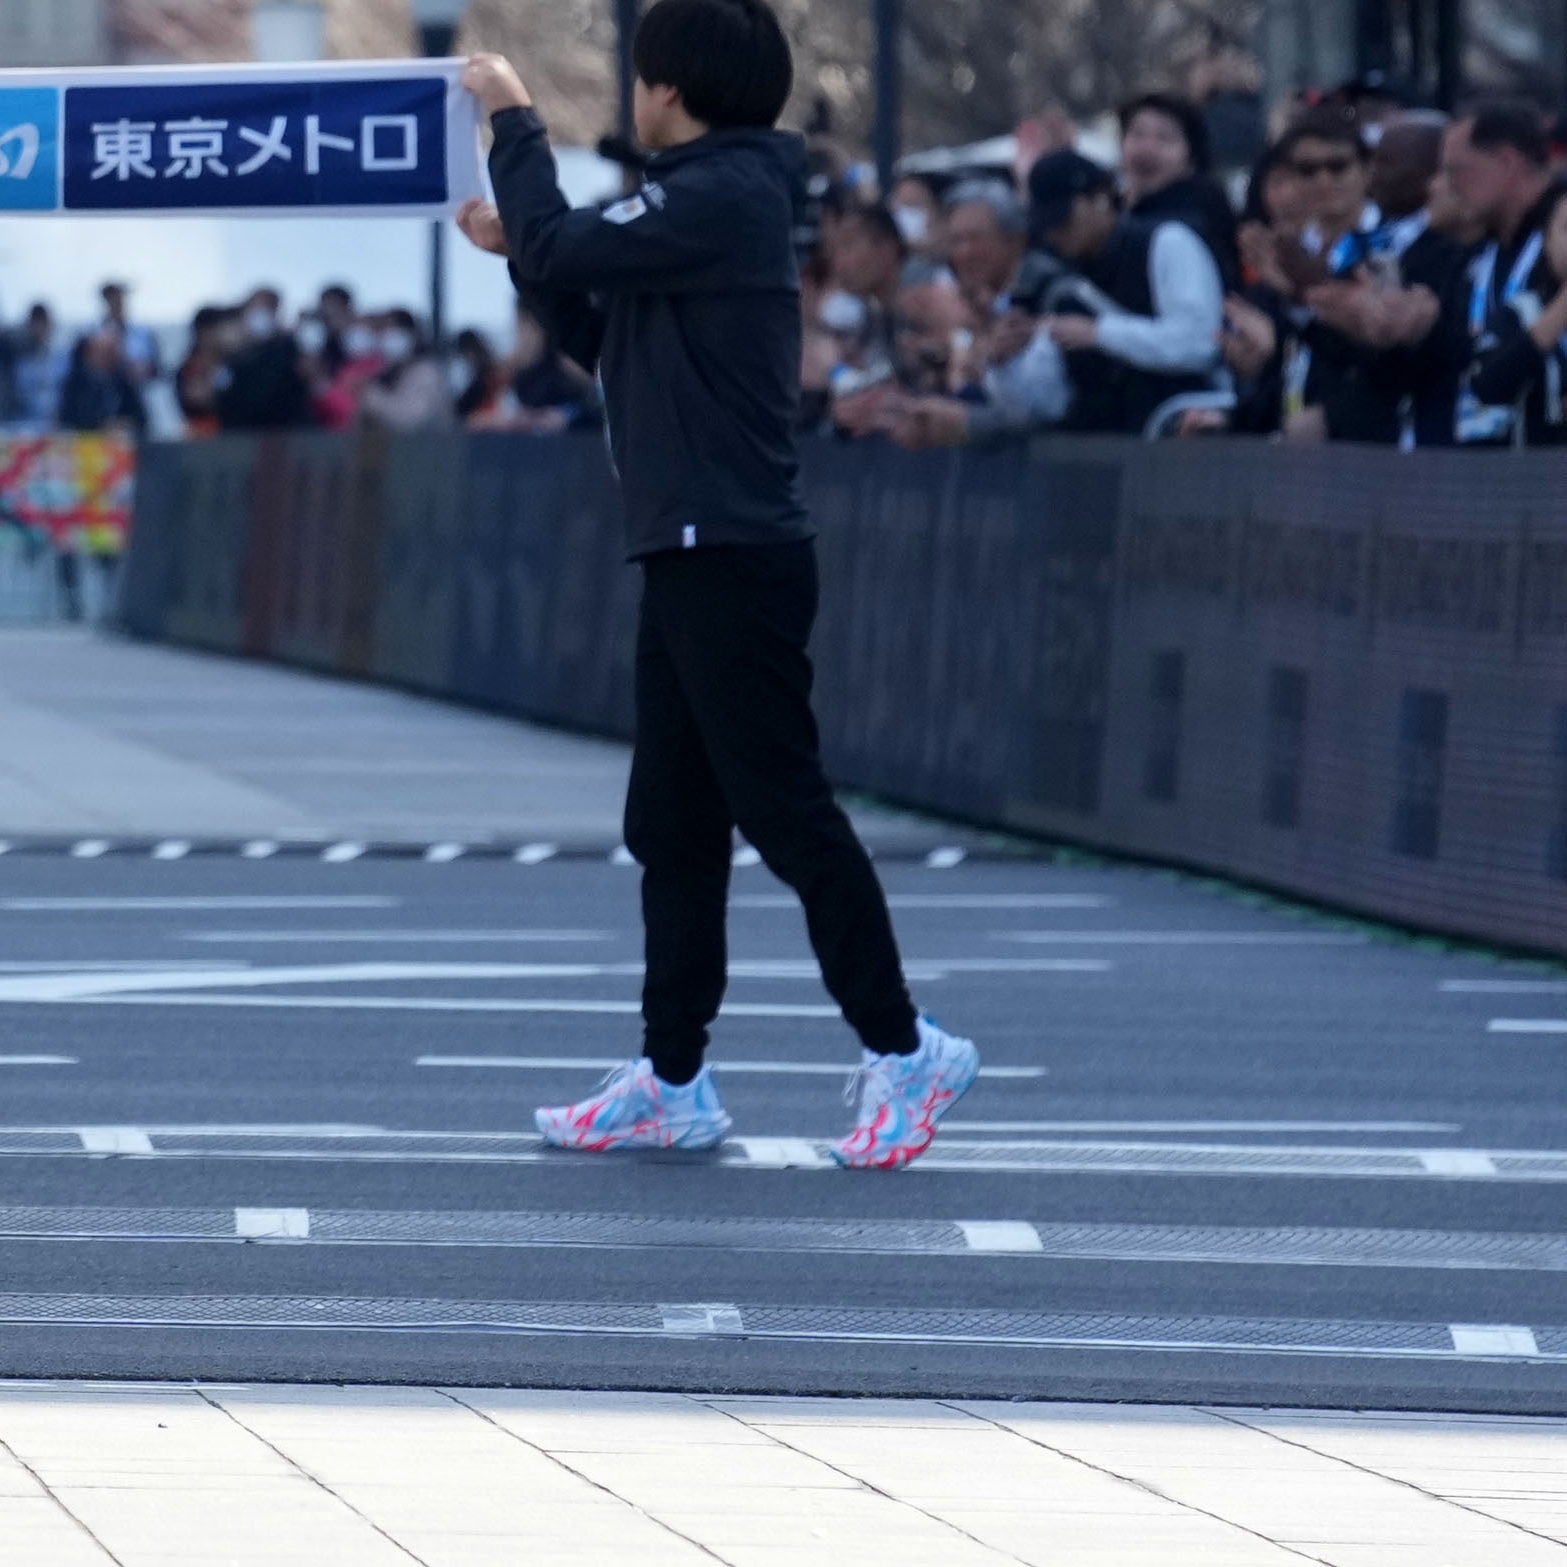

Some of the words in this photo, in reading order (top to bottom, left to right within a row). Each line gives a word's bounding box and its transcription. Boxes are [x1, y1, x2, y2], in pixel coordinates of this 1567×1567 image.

[89, 114, 418, 181] 東京メトロ
